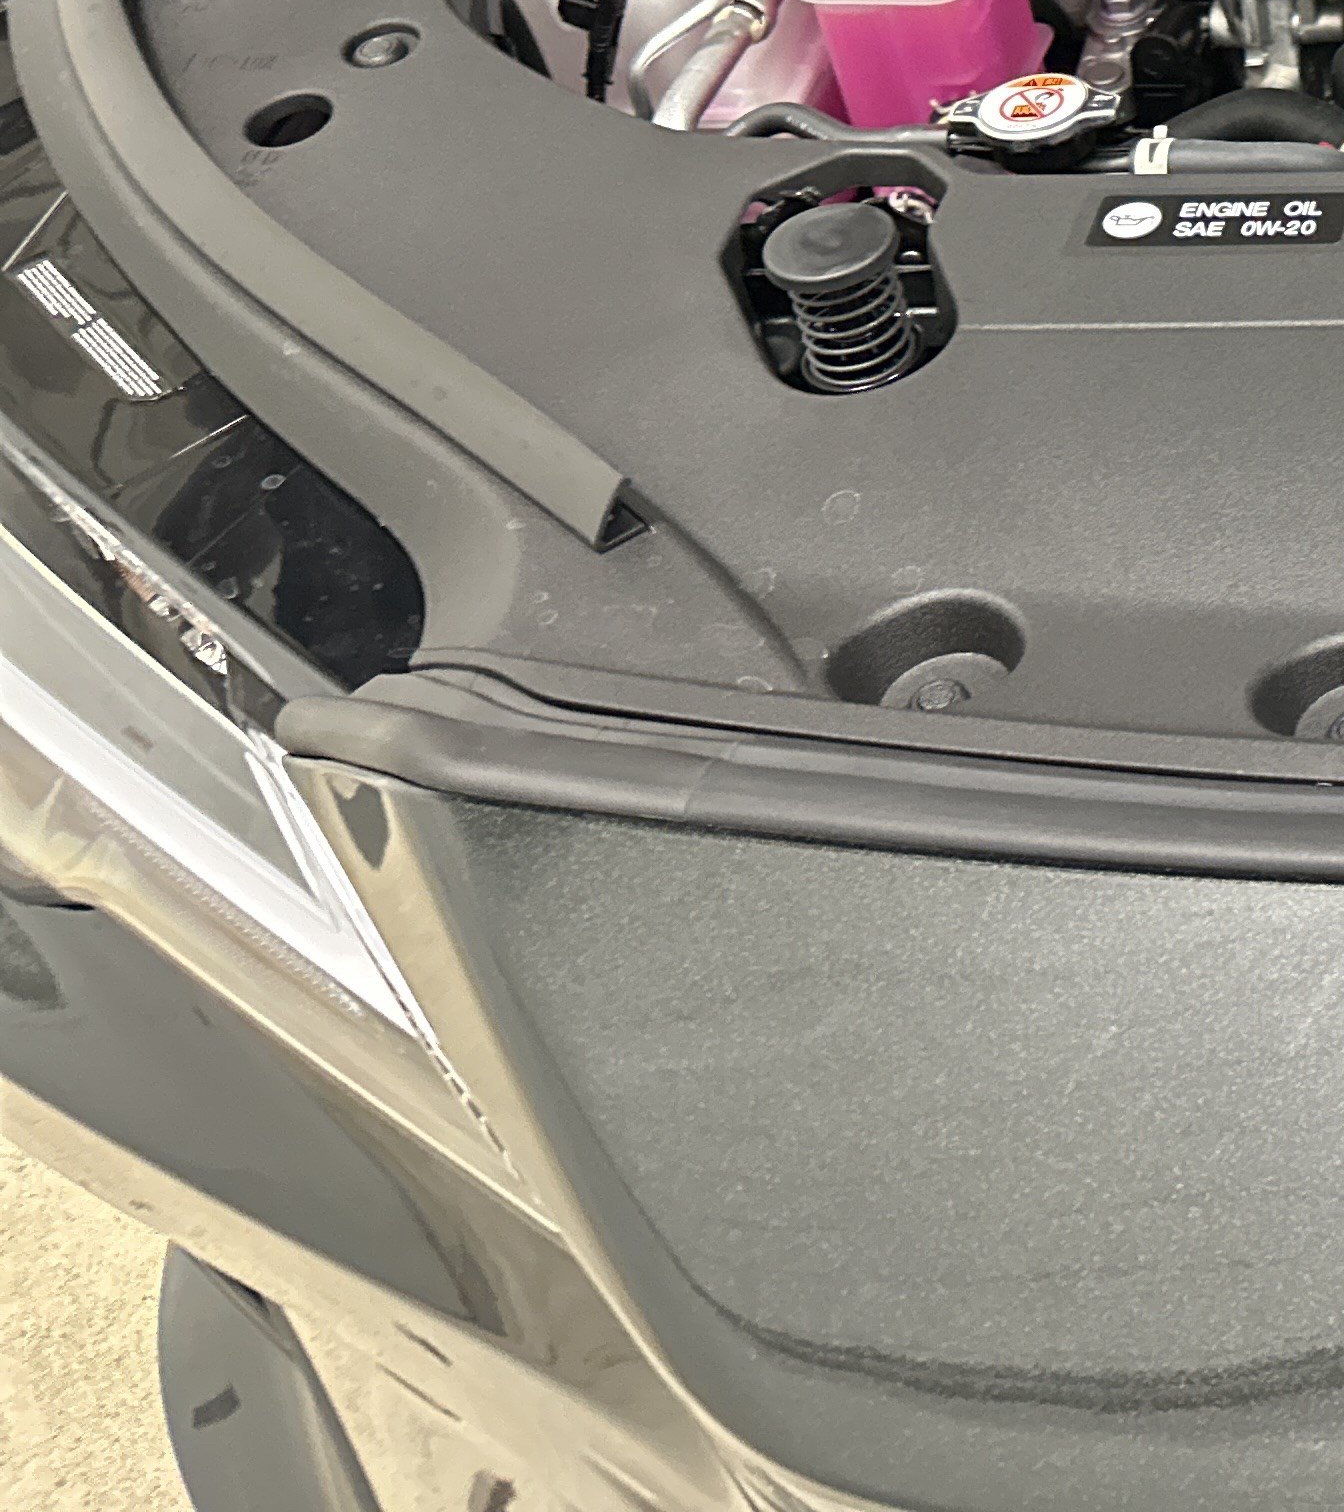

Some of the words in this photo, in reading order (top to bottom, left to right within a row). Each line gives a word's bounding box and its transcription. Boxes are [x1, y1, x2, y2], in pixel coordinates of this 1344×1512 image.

[1179, 201, 1270, 218] ENGINE
[1283, 200, 1322, 216] OIL
[1172, 221, 1225, 237] SAE
[1240, 220, 1317, 236] 0W-20
